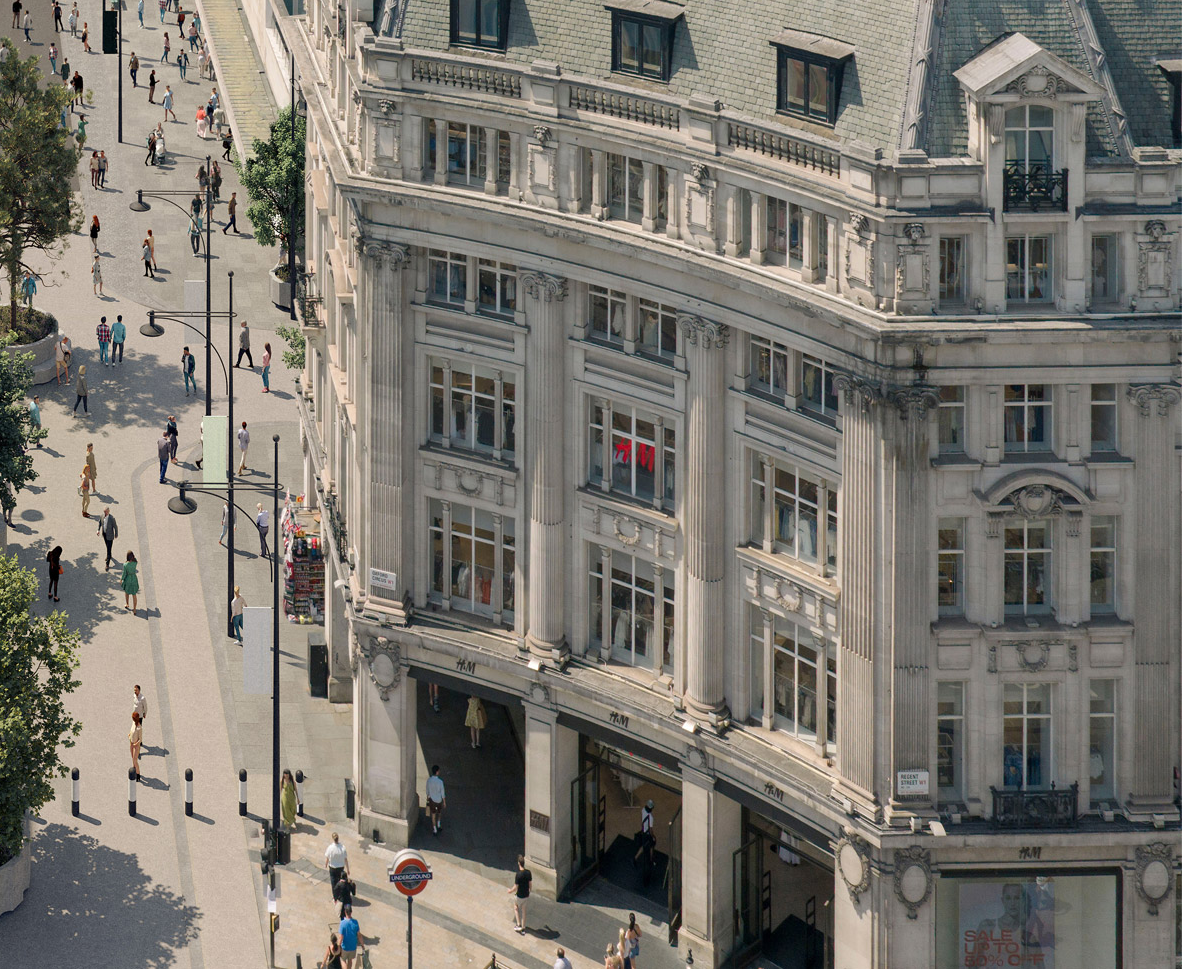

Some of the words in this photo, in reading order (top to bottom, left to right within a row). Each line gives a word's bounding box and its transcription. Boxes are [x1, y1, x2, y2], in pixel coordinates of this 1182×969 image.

[372, 575, 387, 583] CIRCUS
[456, 658, 476, 674] H&M
[609, 711, 629, 729] H&M
[391, 873, 431, 881] UNDERGROUND
[964, 930, 1013, 942] SALE
[964, 942, 990, 955] UP
[996, 942, 1020, 954] TO
[964, 955, 1004, 967] 50%
[1007, 954, 1045, 967] OFF
